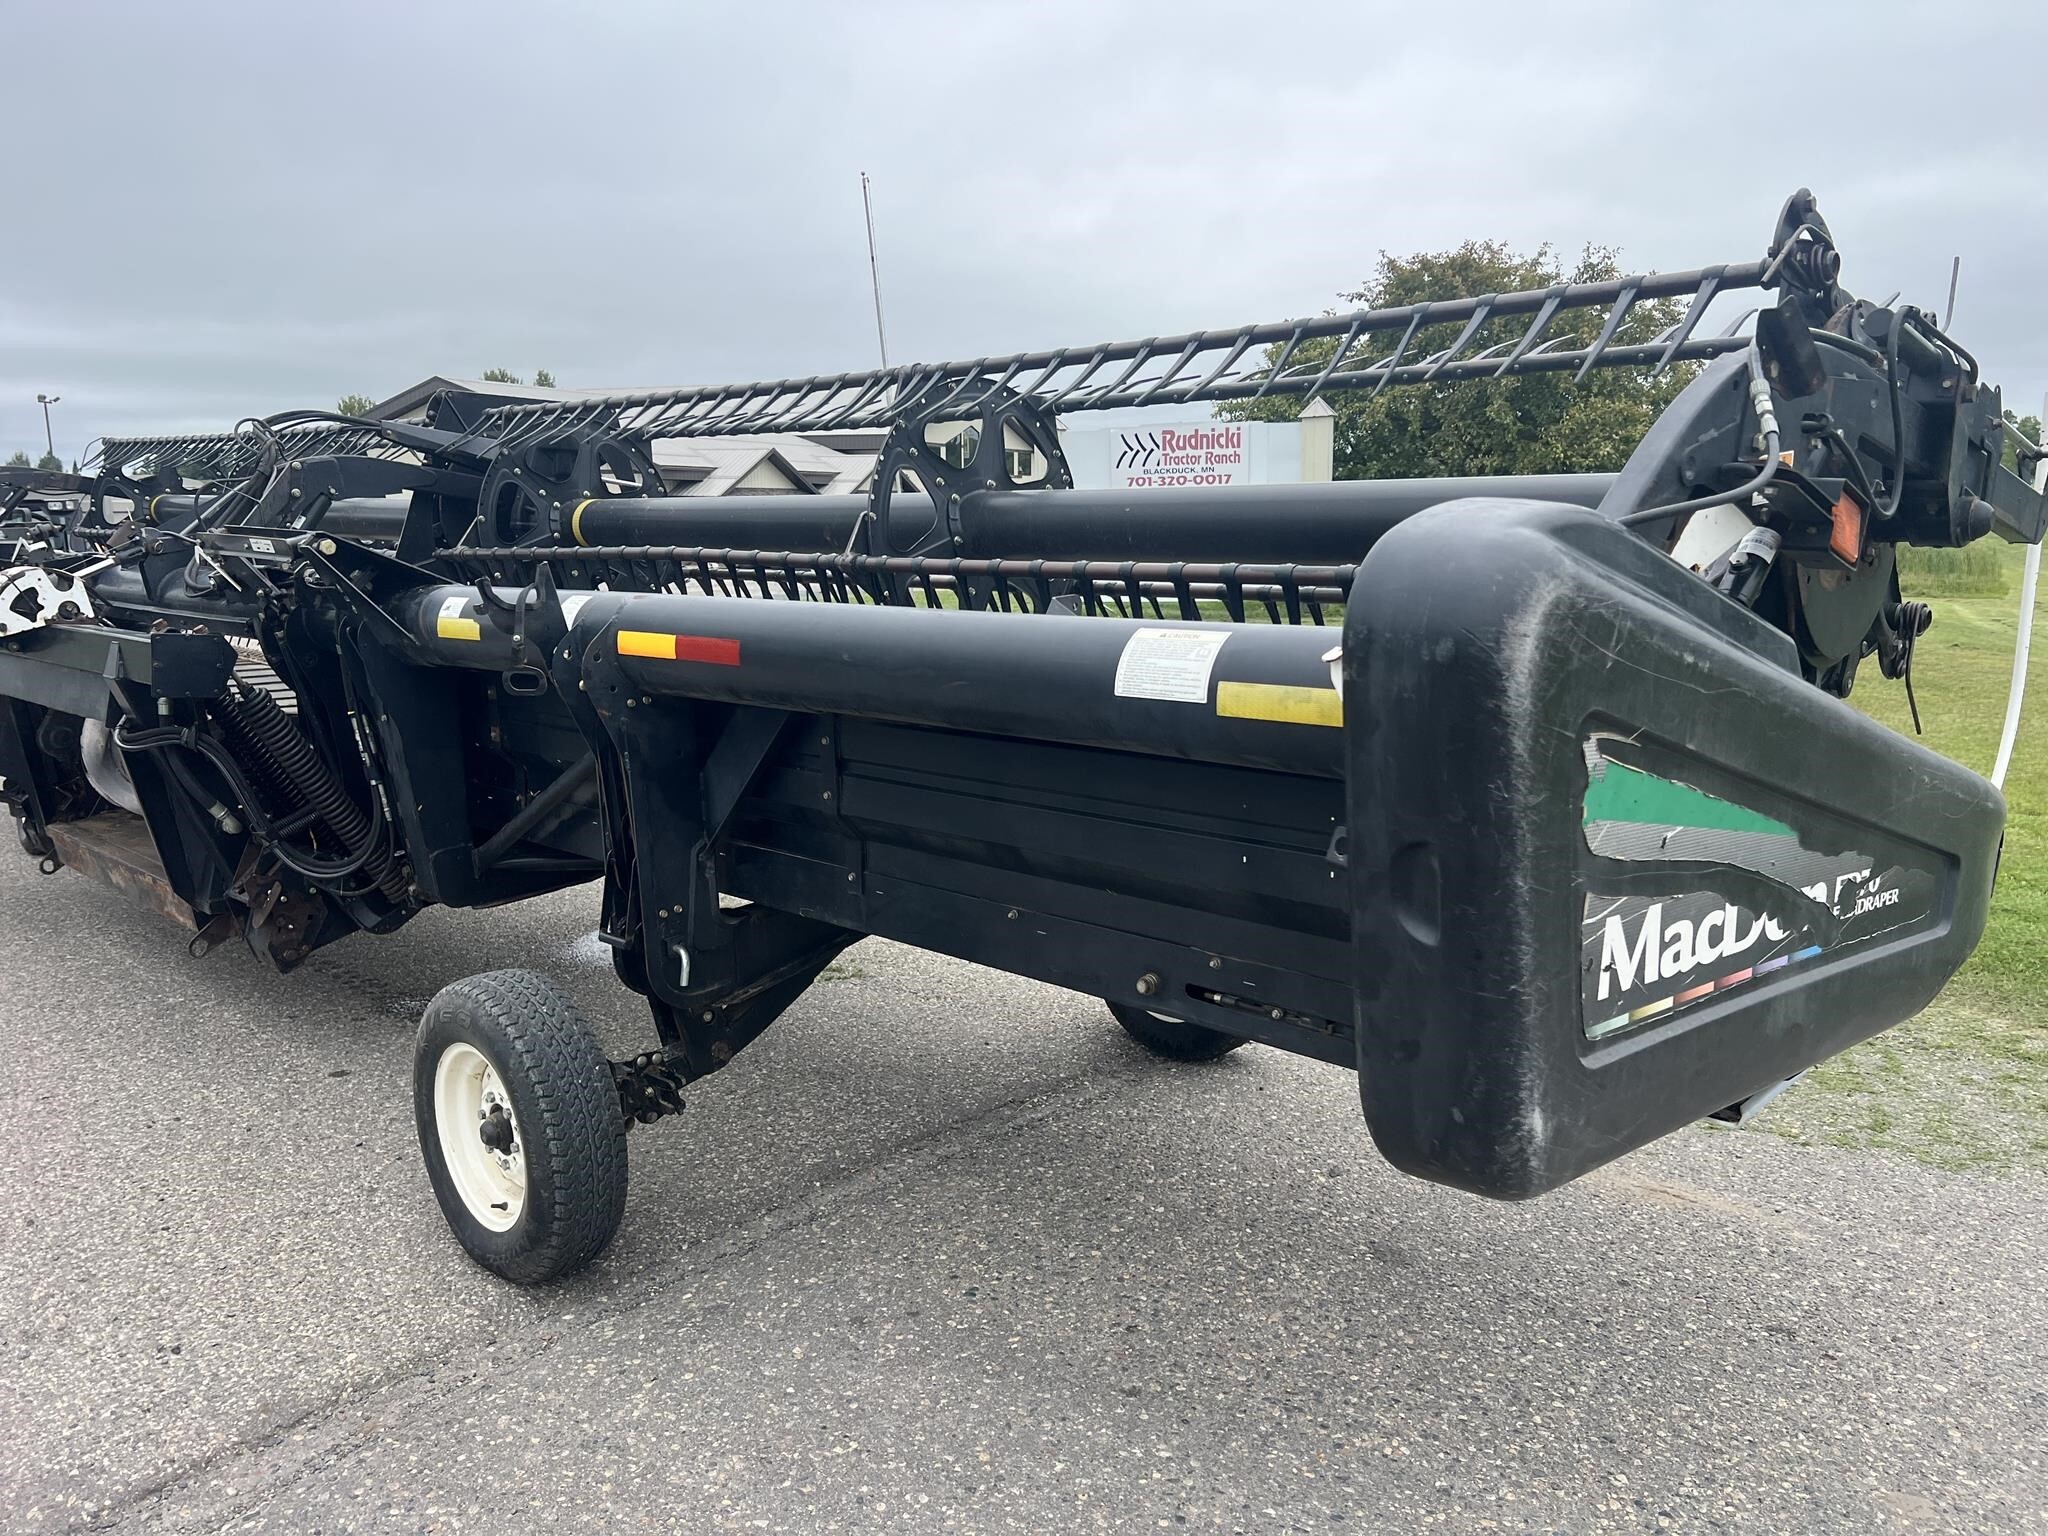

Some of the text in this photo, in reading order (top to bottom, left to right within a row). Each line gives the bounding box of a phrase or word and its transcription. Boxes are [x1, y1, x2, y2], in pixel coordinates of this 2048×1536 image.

[1161, 427, 1241, 453] Rudnicki
[1162, 450, 1241, 466] Tractor Ranch
[1127, 474, 1232, 487] 701-320-0017
